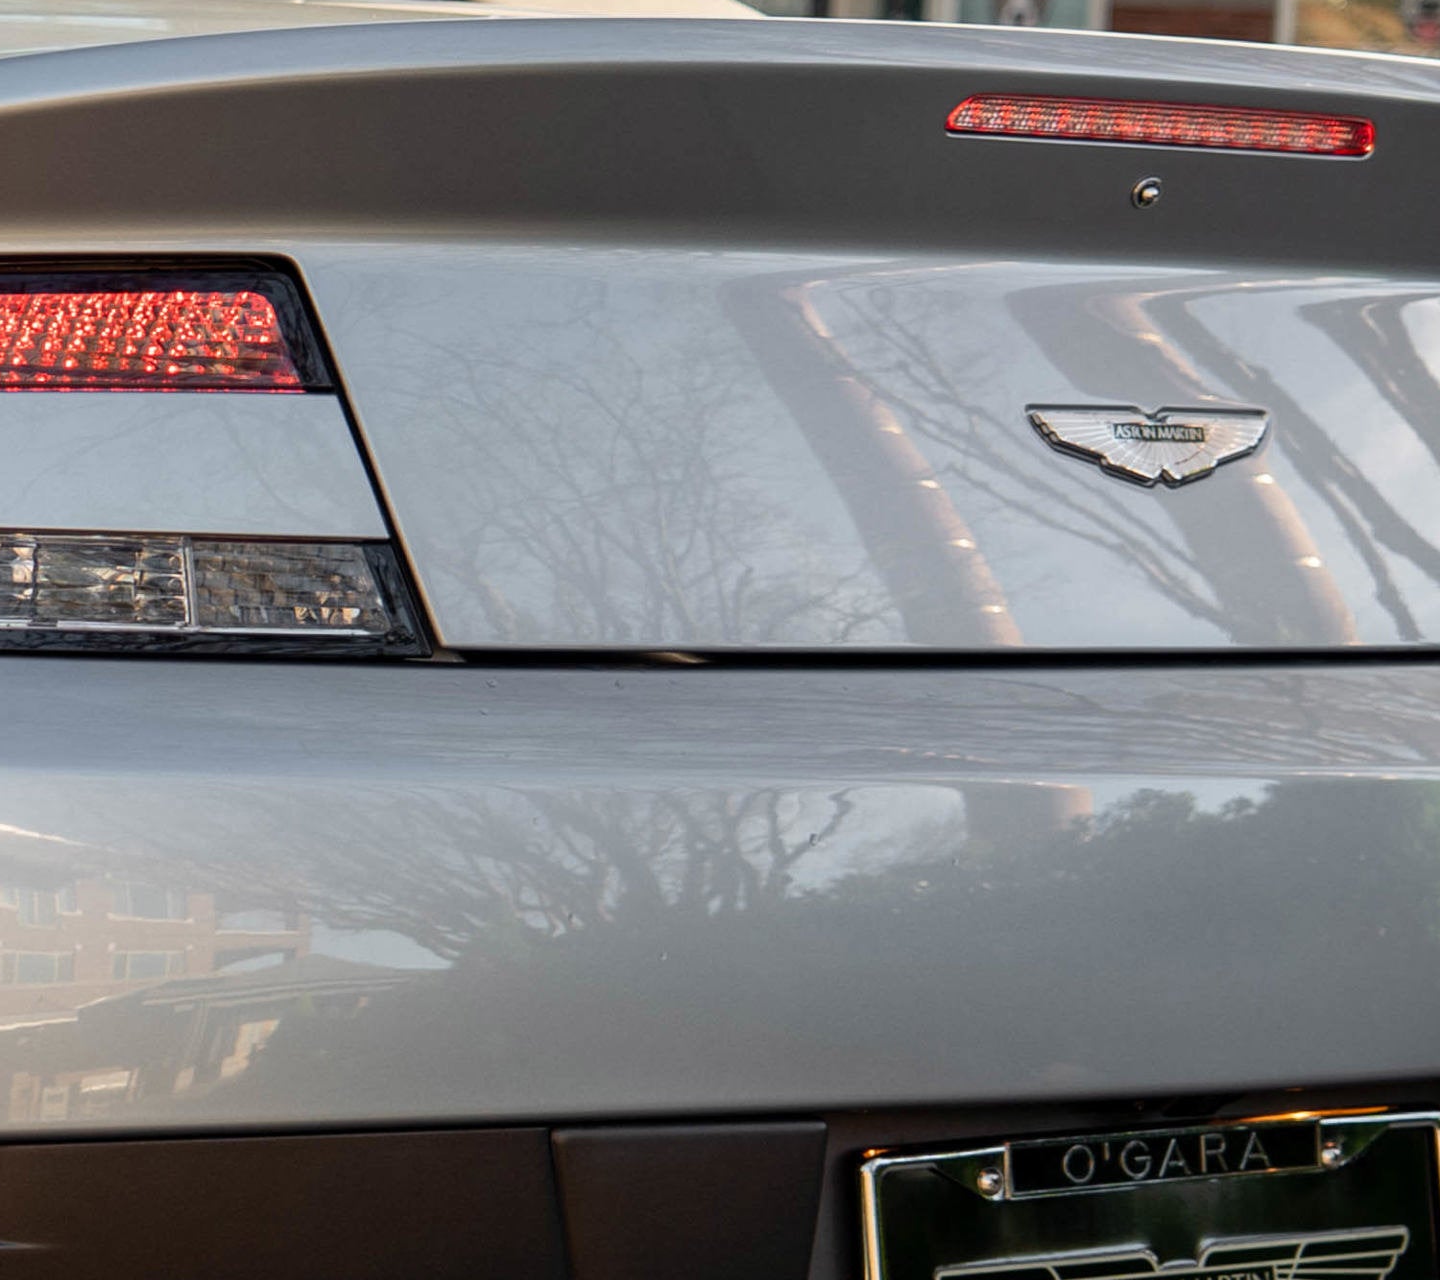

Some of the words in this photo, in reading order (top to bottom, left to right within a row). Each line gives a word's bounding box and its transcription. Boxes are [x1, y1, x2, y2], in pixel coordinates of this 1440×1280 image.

[1115, 424, 1157, 439] ASTON
[1158, 425, 1203, 440] MARTIN
[1061, 1131, 1272, 1184] O'GARA
